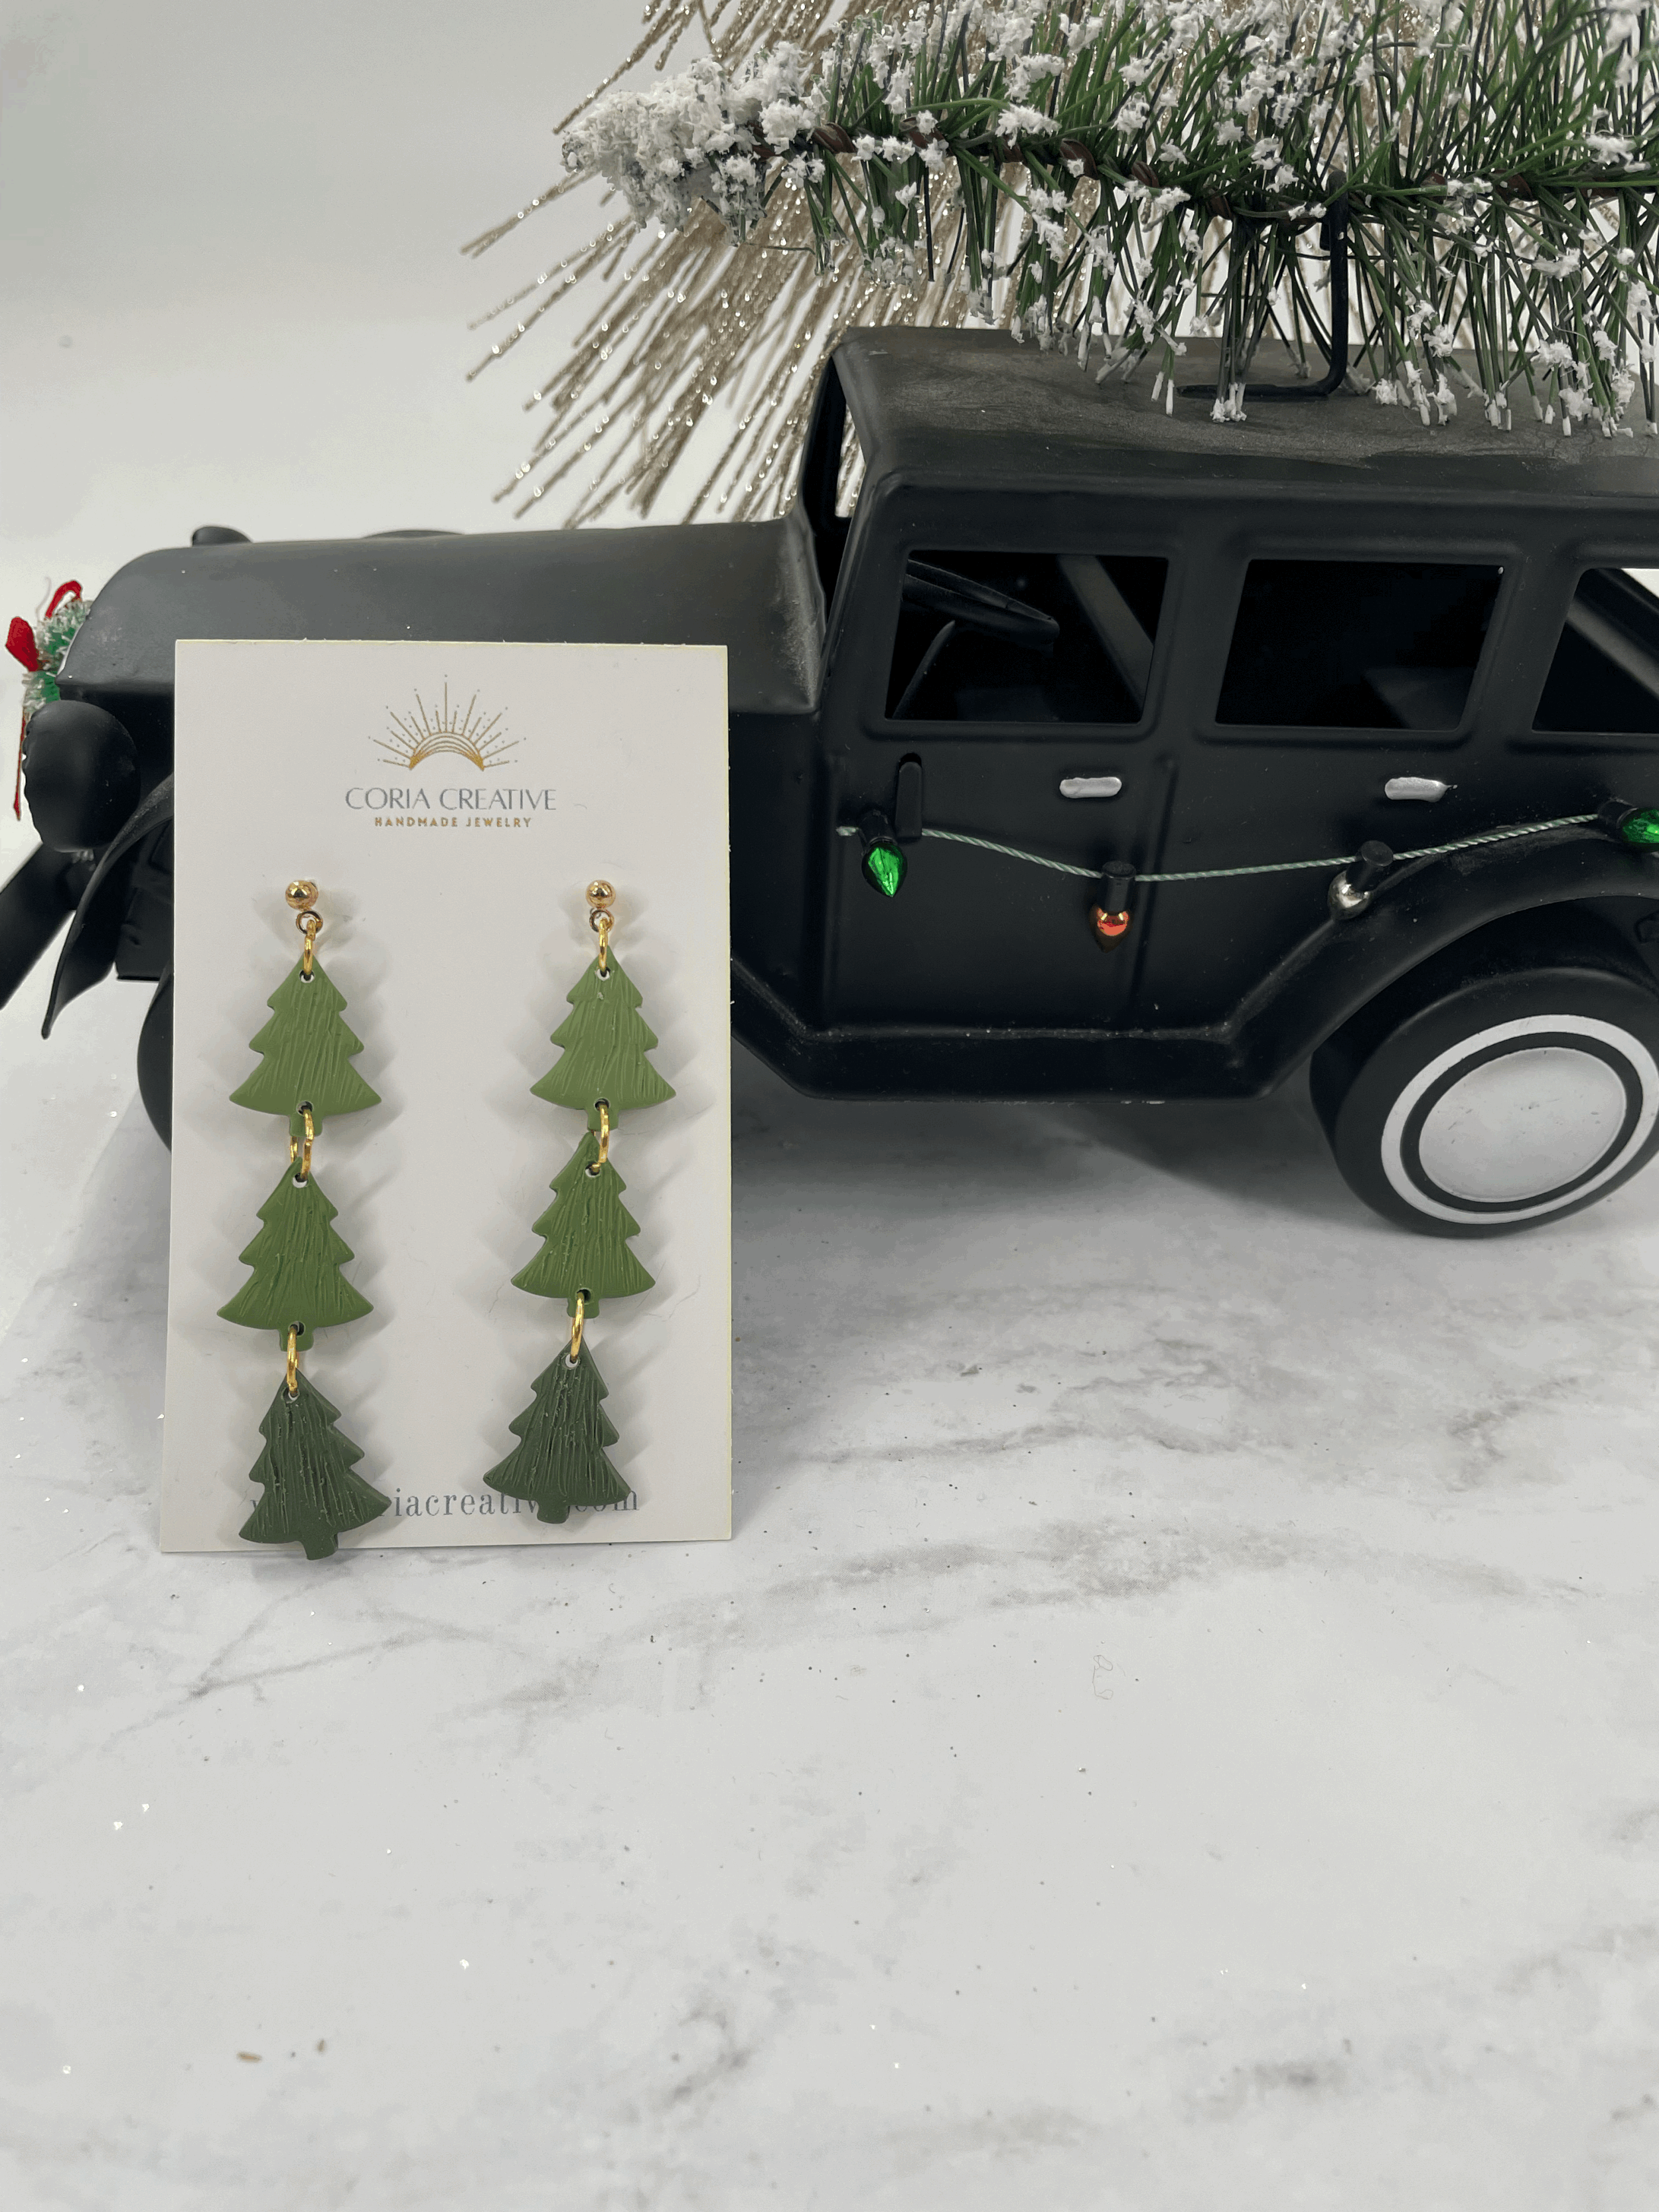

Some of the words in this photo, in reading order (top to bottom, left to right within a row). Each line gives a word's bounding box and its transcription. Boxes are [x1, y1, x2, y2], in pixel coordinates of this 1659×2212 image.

[345, 787, 431, 810] CORIA
[439, 788, 557, 810] CREATIVE
[374, 816, 459, 828] HANDMADE
[466, 817, 532, 828] JEWELRY
